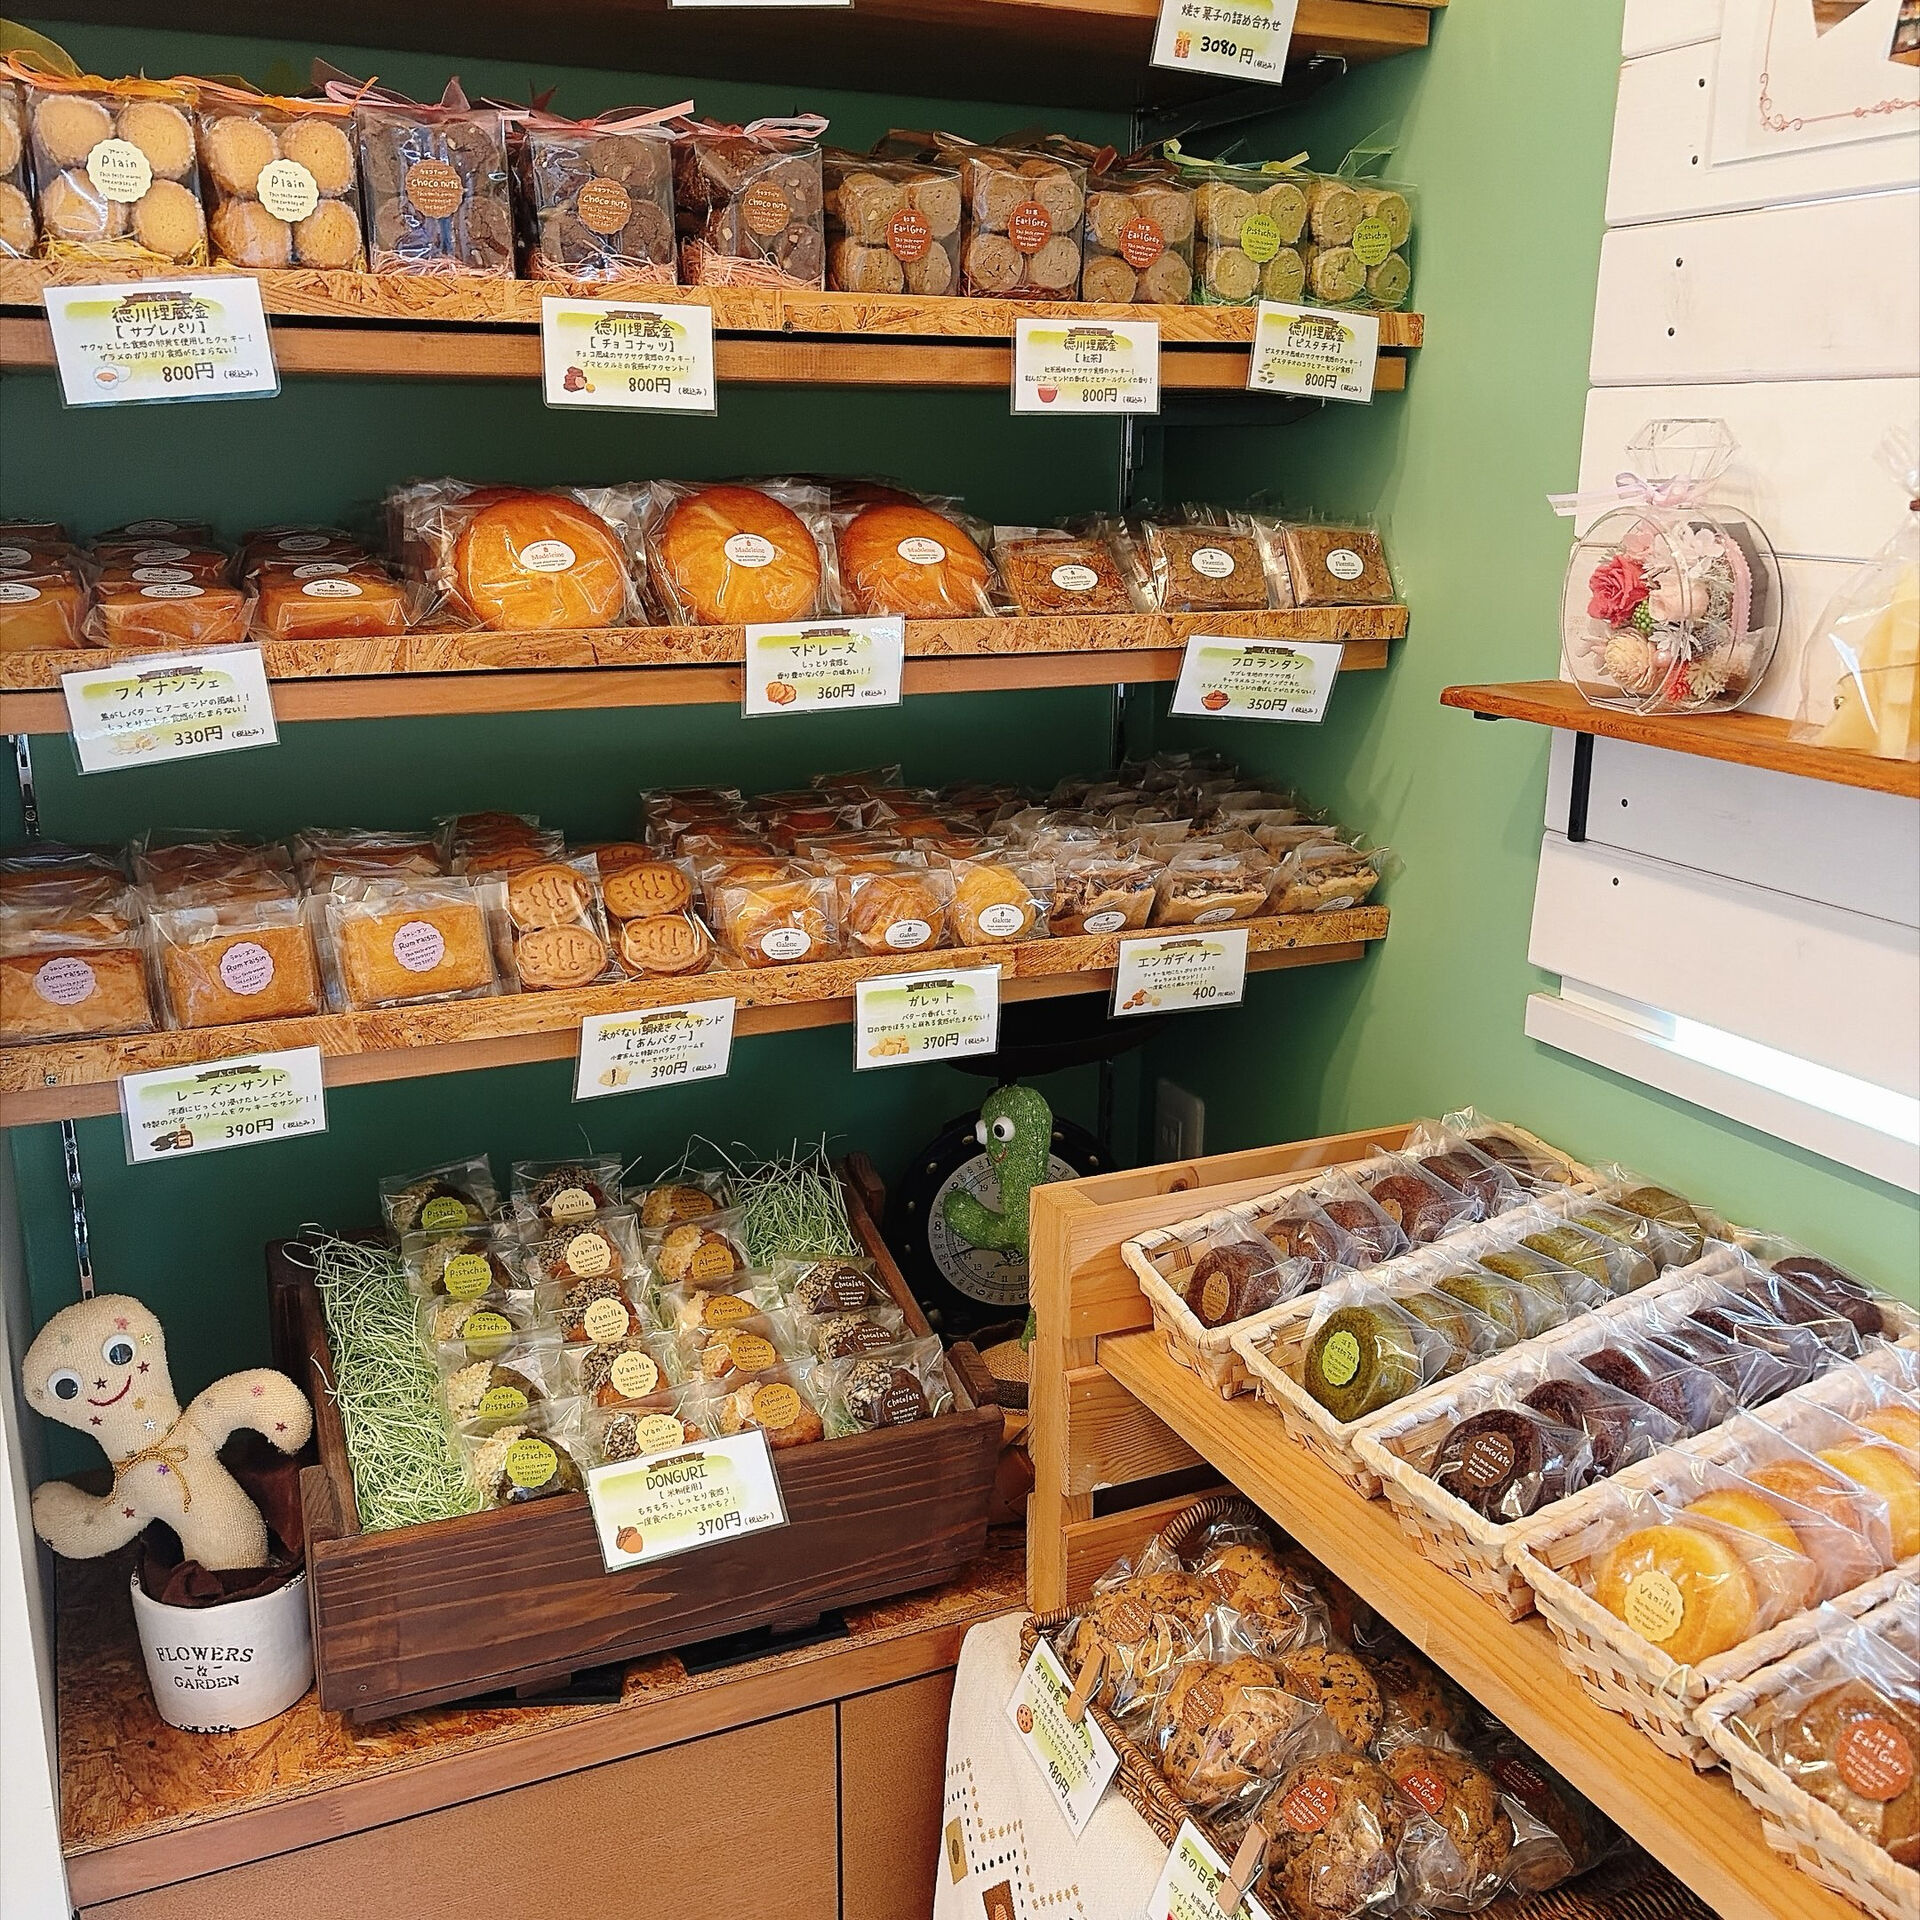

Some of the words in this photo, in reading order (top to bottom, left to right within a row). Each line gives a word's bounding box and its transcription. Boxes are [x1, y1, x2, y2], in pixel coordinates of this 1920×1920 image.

[1181, 3, 1281, 31] 焼き菓子の詰め合わせ
[1200, 36, 1237, 57] 3080
[1239, 47, 1254, 65] 円
[102, 155, 137, 168] Plain
[271, 174, 306, 189] Plain
[411, 178, 439, 188] Choco
[440, 180, 459, 189] nuts
[583, 194, 610, 206] Choco
[611, 199, 628, 210] nuts
[748, 198, 772, 208] Choco
[772, 201, 788, 211] nuts
[893, 223, 910, 234] Earl
[910, 226, 927, 236] Grey
[1016, 217, 1032, 226] Earl
[1032, 218, 1048, 229] Grey
[1128, 231, 1144, 240] Earl
[1144, 233, 1160, 244] Grey
[112, 302, 210, 323] 徳川埋蔵金
[595, 320, 675, 340] 徳川埋蔵金
[1289, 322, 1348, 343] 徳川埋蔵金
[1064, 338, 1119, 352] 徳川埋蔵金
[162, 362, 214, 383] 800円
[224, 368, 259, 379] (税込み)
[629, 377, 671, 393] 800円
[1305, 373, 1338, 389] 800円
[1082, 388, 1118, 403] 800円
[531, 551, 565, 561] Madeleine
[789, 642, 858, 658] マドレーヌ
[1231, 657, 1304, 671] フロランタン
[115, 679, 220, 701] フィナンシェ
[817, 683, 855, 700] 360円
[1247, 698, 1288, 712] 350円
[174, 725, 223, 747] 330円
[399, 939, 418, 951] Rum
[417, 933, 438, 945] raisin
[226, 963, 244, 974] Rum
[244, 955, 267, 967] raisin
[1137, 950, 1222, 968] エンガディナー
[43, 972, 64, 982] Rum
[64, 968, 89, 978] raisin
[908, 992, 954, 1007] ガレット
[1192, 985, 1217, 1000] 400
[598, 1015, 725, 1042] 泳がない鯛焼きくんサンド
[922, 1032, 960, 1050] 370円
[650, 1060, 688, 1079] 390円
[176, 1074, 286, 1103] レーズンサンド
[225, 1117, 274, 1139] 390円
[558, 1200, 590, 1210] Vanilla
[427, 1208, 463, 1219] Pistachio
[934, 1221, 942, 1231] 8
[572, 1243, 603, 1258] Vanilla
[699, 1256, 726, 1267] Almond
[449, 1266, 487, 1277] Pistachio
[833, 1280, 866, 1289] Chocolate
[590, 1310, 622, 1323] Vanilla
[713, 1307, 743, 1316] Almond
[469, 1323, 508, 1332] Pistachio
[857, 1331, 890, 1342] Chocolate
[617, 1363, 650, 1375] Vanilla
[485, 1401, 524, 1412] Pistachio
[760, 1394, 791, 1408] Almond
[887, 1393, 920, 1408] Chocolate
[512, 1451, 552, 1463] Pistachio
[1475, 1440, 1511, 1467] Chocolate
[646, 1464, 708, 1491] DONGURI
[697, 1511, 741, 1536] 370円
[1639, 1584, 1676, 1617] Vanilla
[156, 1646, 254, 1663] FLOWERS
[174, 1675, 240, 1690] GARDEN
[1190, 1688, 1206, 1706] Choco
[1853, 1730, 1881, 1755] Earl
[1878, 1749, 1906, 1776] Grey
[1047, 1759, 1071, 1799] 480円
[1408, 1776, 1423, 1792] Earl
[1421, 1788, 1436, 1806] Grey
[1300, 1787, 1317, 1801] Earl
[1313, 1798, 1327, 1815] Grey
